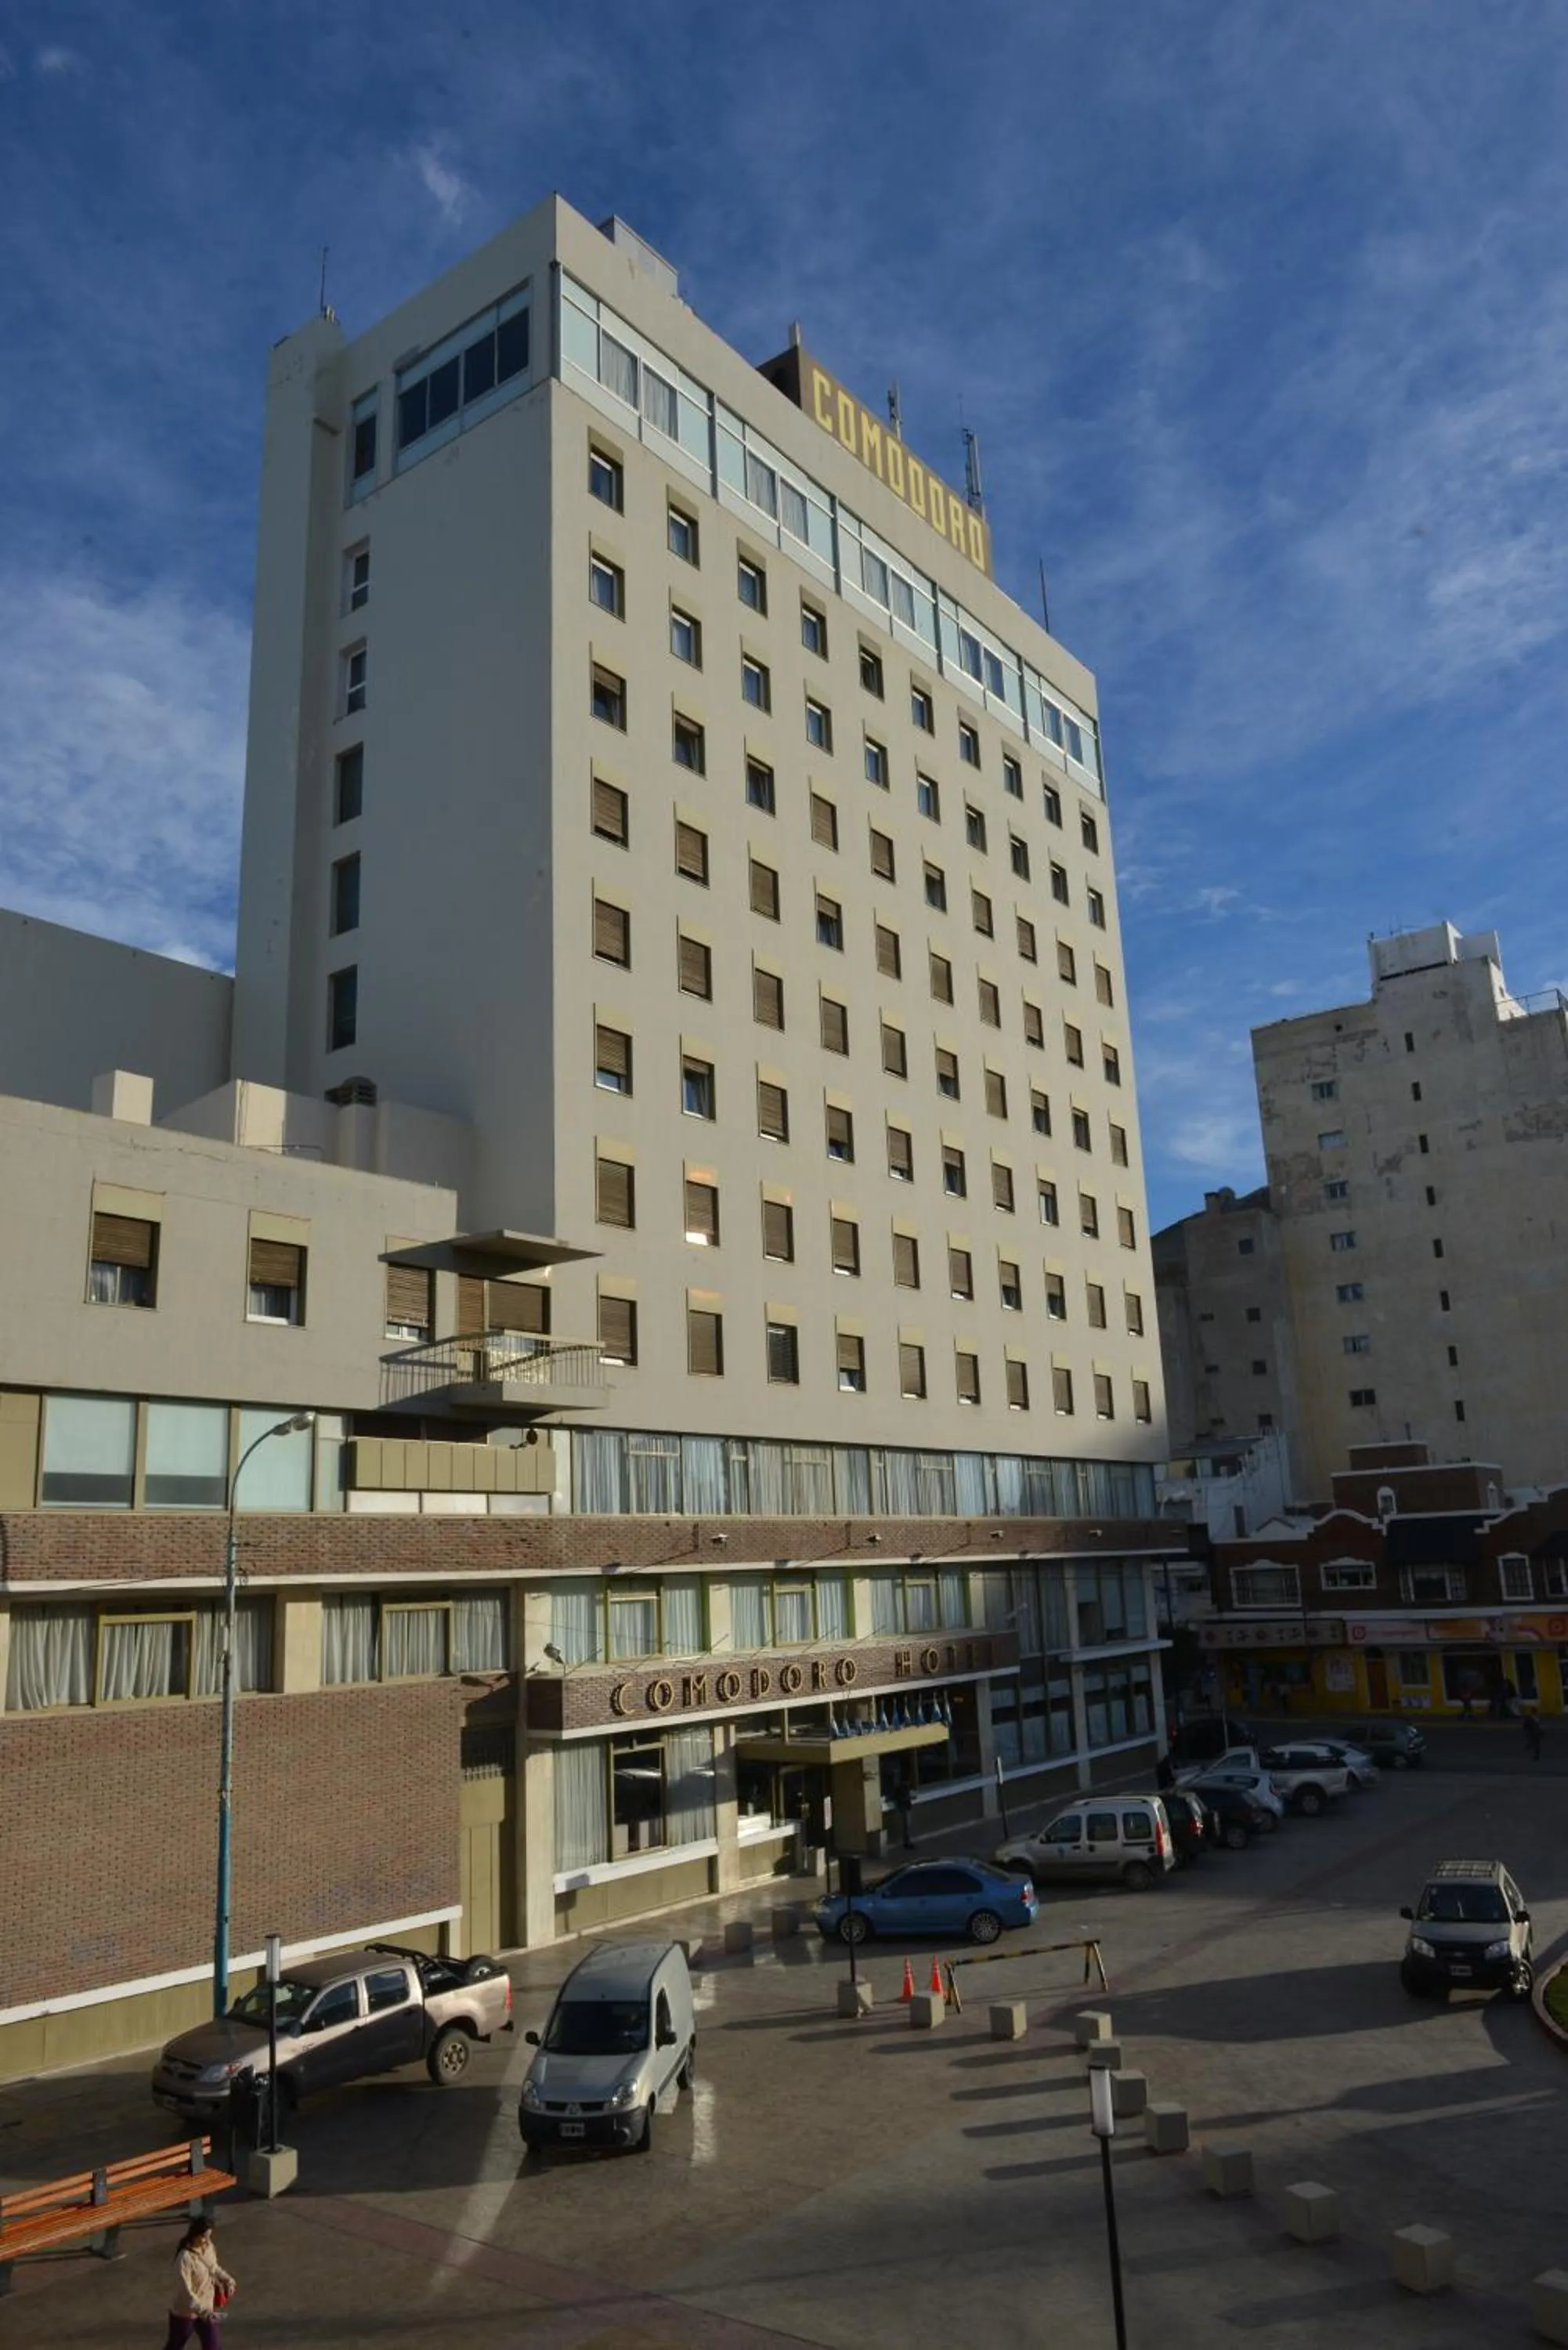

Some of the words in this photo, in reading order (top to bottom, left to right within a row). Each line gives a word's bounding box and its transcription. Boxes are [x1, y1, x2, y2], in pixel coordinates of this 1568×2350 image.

[812, 367, 986, 573] COMODORO
[610, 1657, 857, 1716] COMODORO
[894, 1640, 999, 1677] HOT
